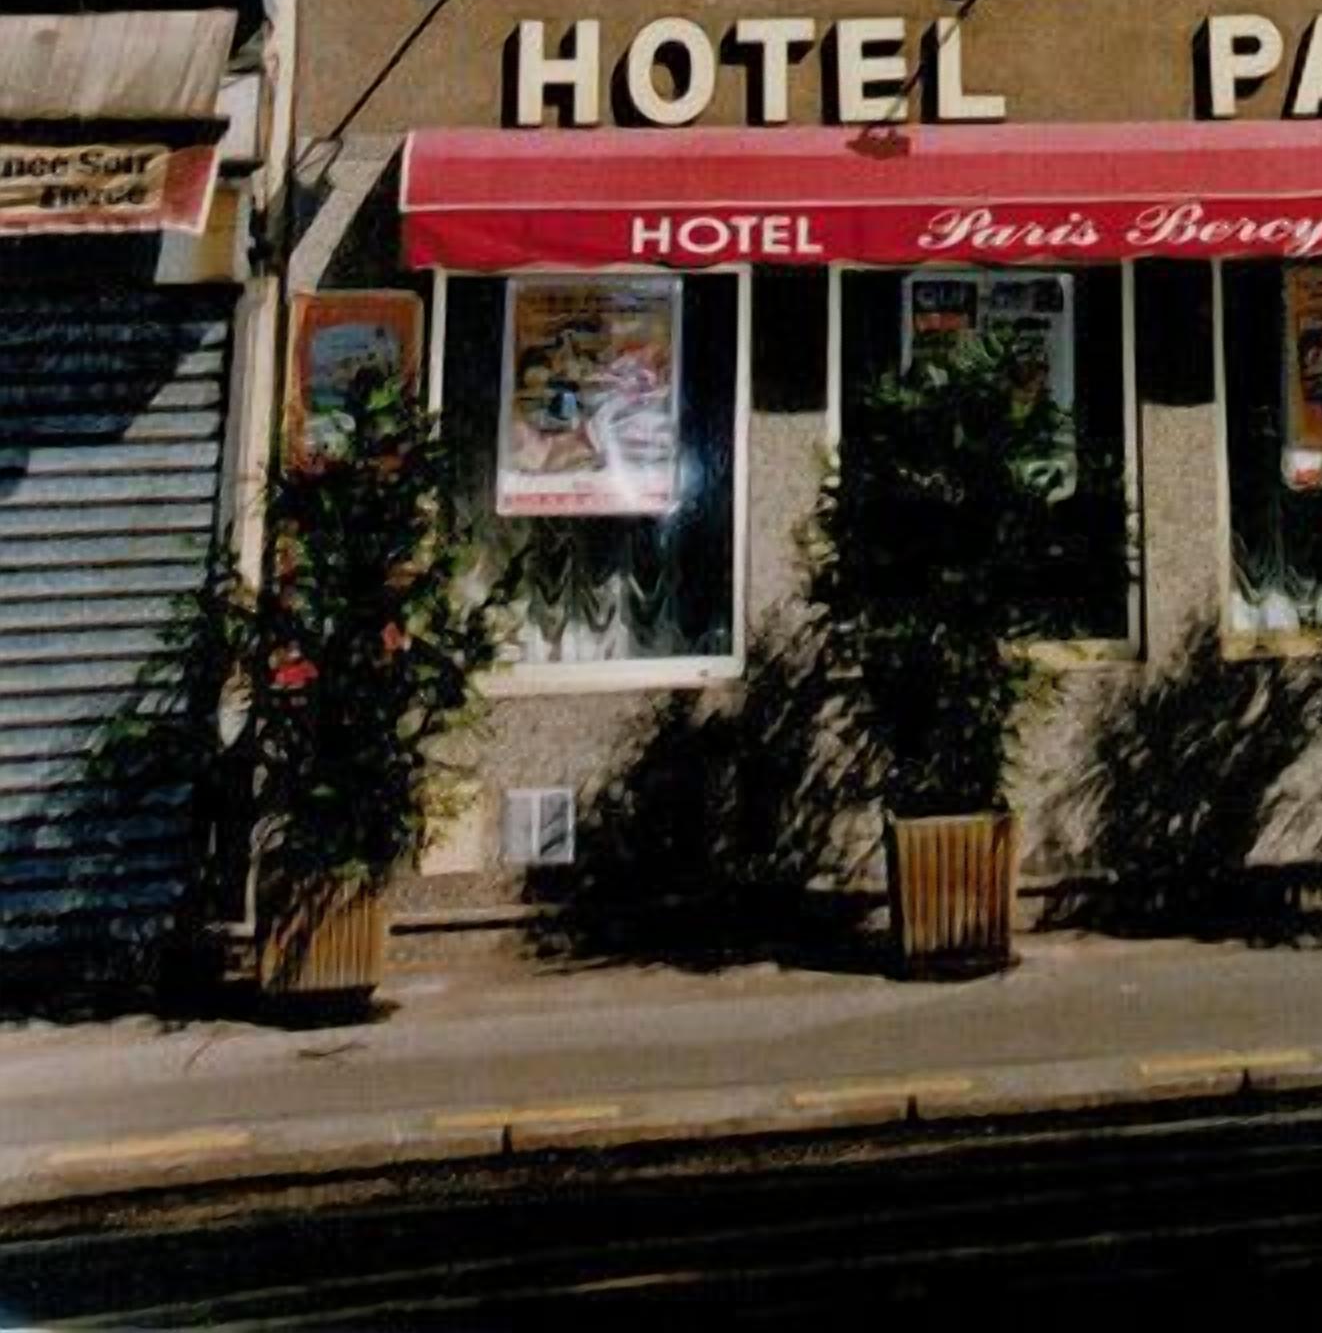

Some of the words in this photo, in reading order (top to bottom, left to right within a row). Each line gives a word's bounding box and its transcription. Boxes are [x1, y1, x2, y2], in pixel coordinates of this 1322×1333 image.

[516, 16, 1006, 125] HOTEL
[632, 215, 823, 256] HOTEL
[918, 208, 1102, 251] Paris
